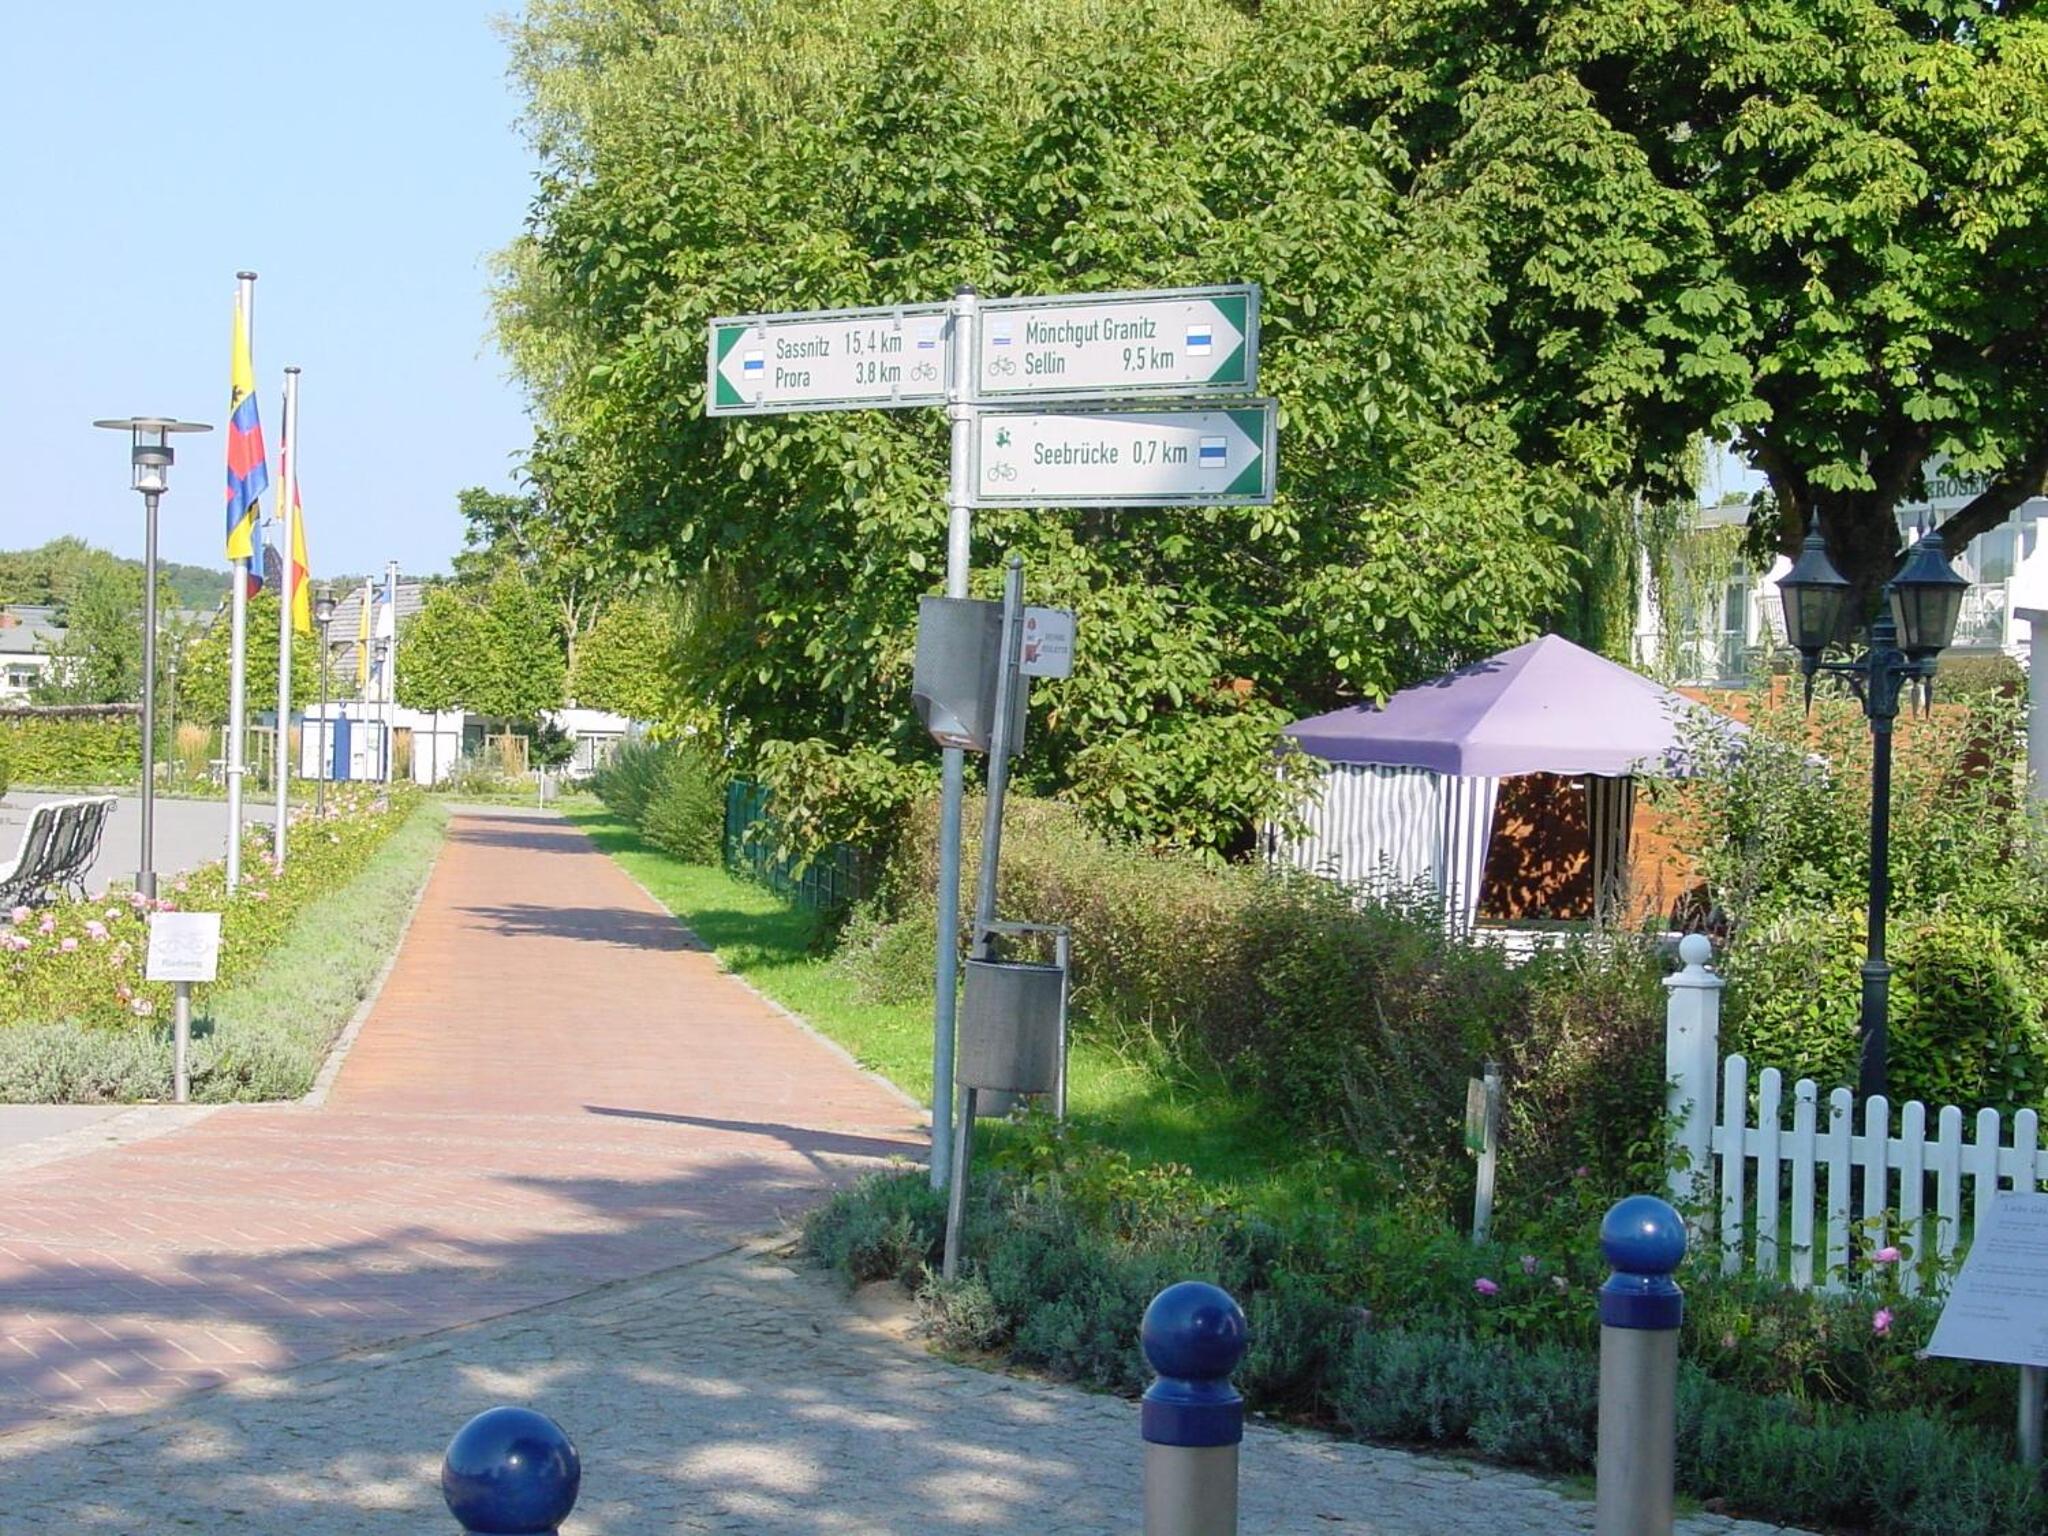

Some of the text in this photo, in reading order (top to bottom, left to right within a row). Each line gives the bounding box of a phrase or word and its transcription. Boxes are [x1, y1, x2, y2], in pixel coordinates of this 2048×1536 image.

[775, 329, 902, 360] Sassnitz 15,4 km
[1025, 317, 1156, 349] Mönchgut Granitz
[775, 360, 901, 389] Prora 3,8 km
[1025, 347, 1174, 375] Sellin 9,5 km
[1033, 440, 1188, 466] Seebrücke 0,7 km
